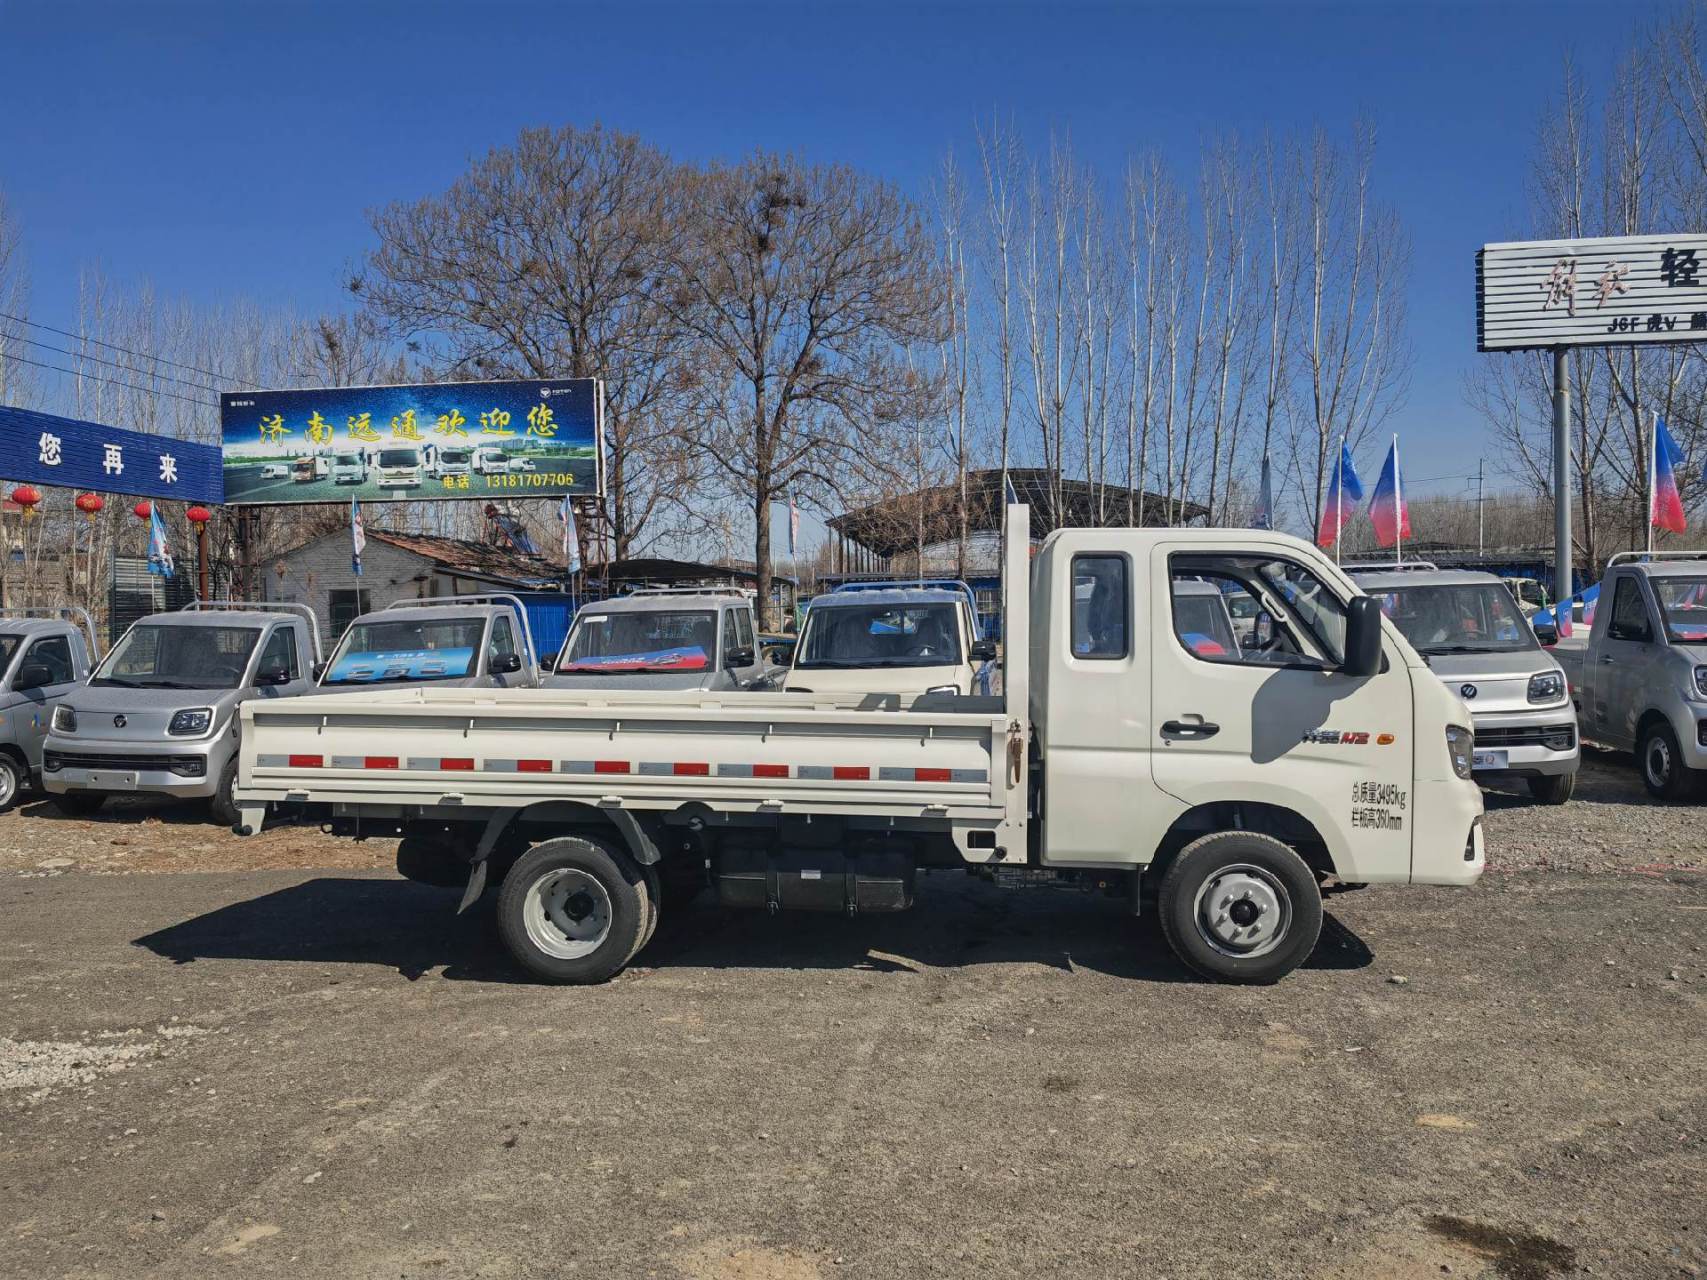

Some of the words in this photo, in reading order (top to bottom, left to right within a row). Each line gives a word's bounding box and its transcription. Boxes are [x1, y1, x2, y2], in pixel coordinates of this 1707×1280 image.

[1660, 247, 1699, 288] 轻
[260, 402, 560, 446] 济南远通欢迎您
[39, 432, 178, 484] 您再来
[442, 474, 470, 489] 电话
[486, 473, 574, 488] 13181707706
[1352, 781, 1406, 810] 总质量3495kg
